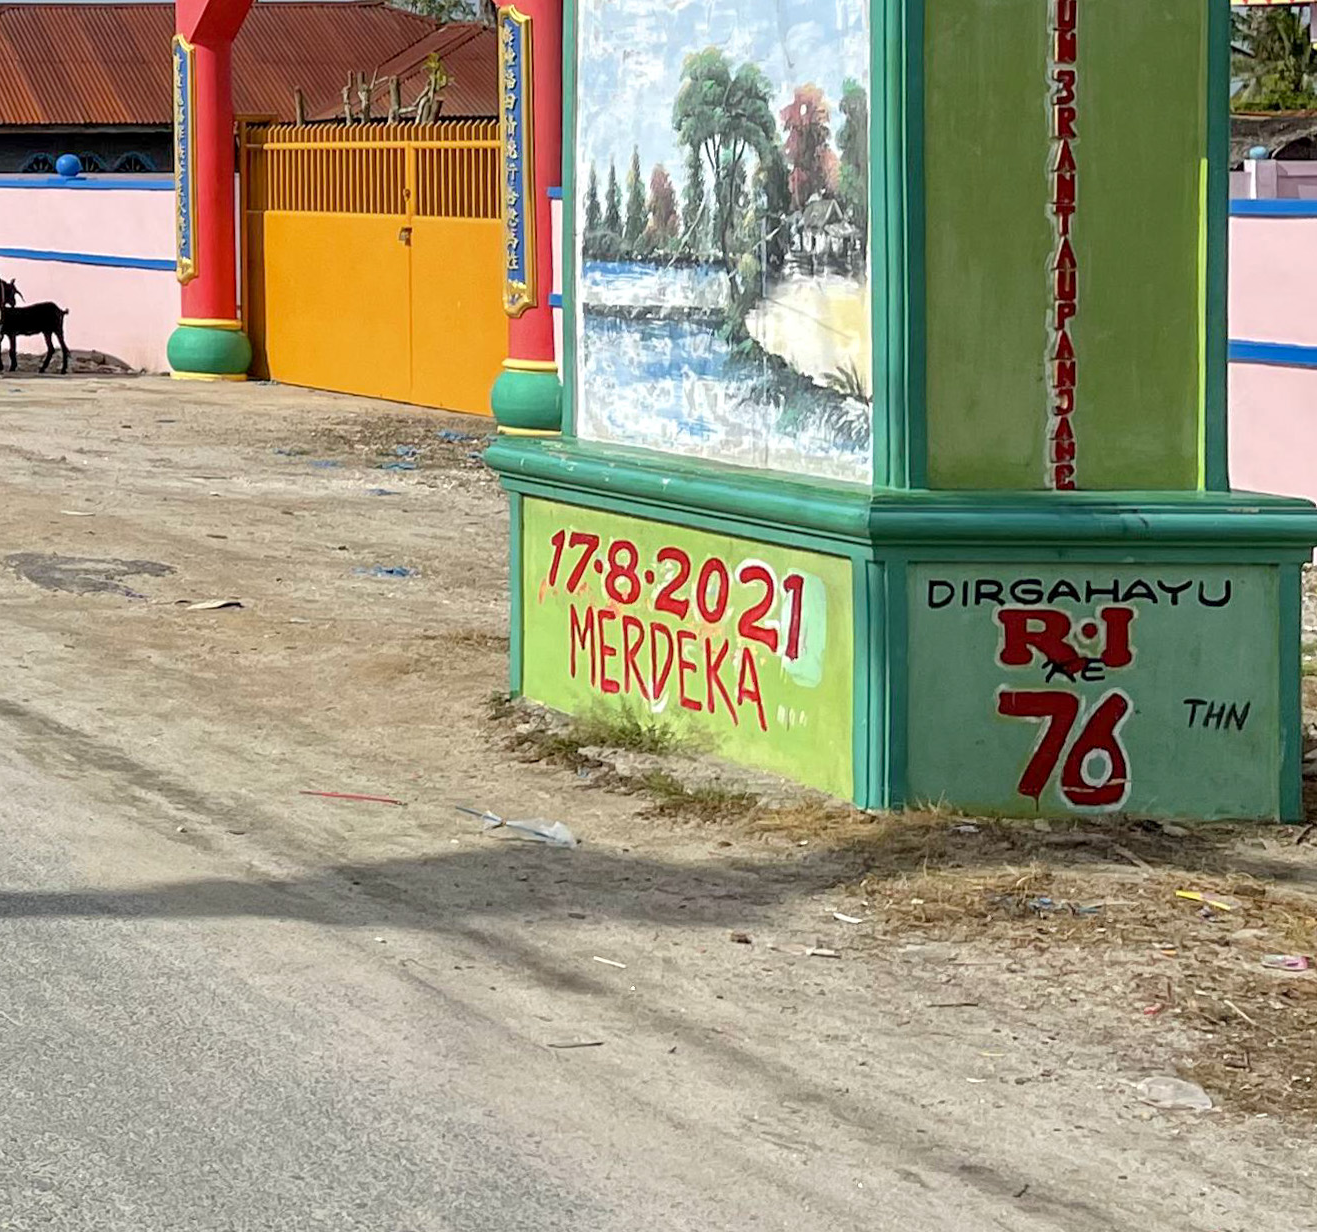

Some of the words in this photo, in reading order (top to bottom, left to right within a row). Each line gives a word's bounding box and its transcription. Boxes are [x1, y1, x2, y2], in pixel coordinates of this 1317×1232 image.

[1052, 69, 1076, 106] 3
[928, 579, 1232, 609] DIRGAHAYU
[570, 603, 768, 732] MERDEKA
[998, 692, 1129, 806] 76
[1183, 698, 1251, 731] THN
